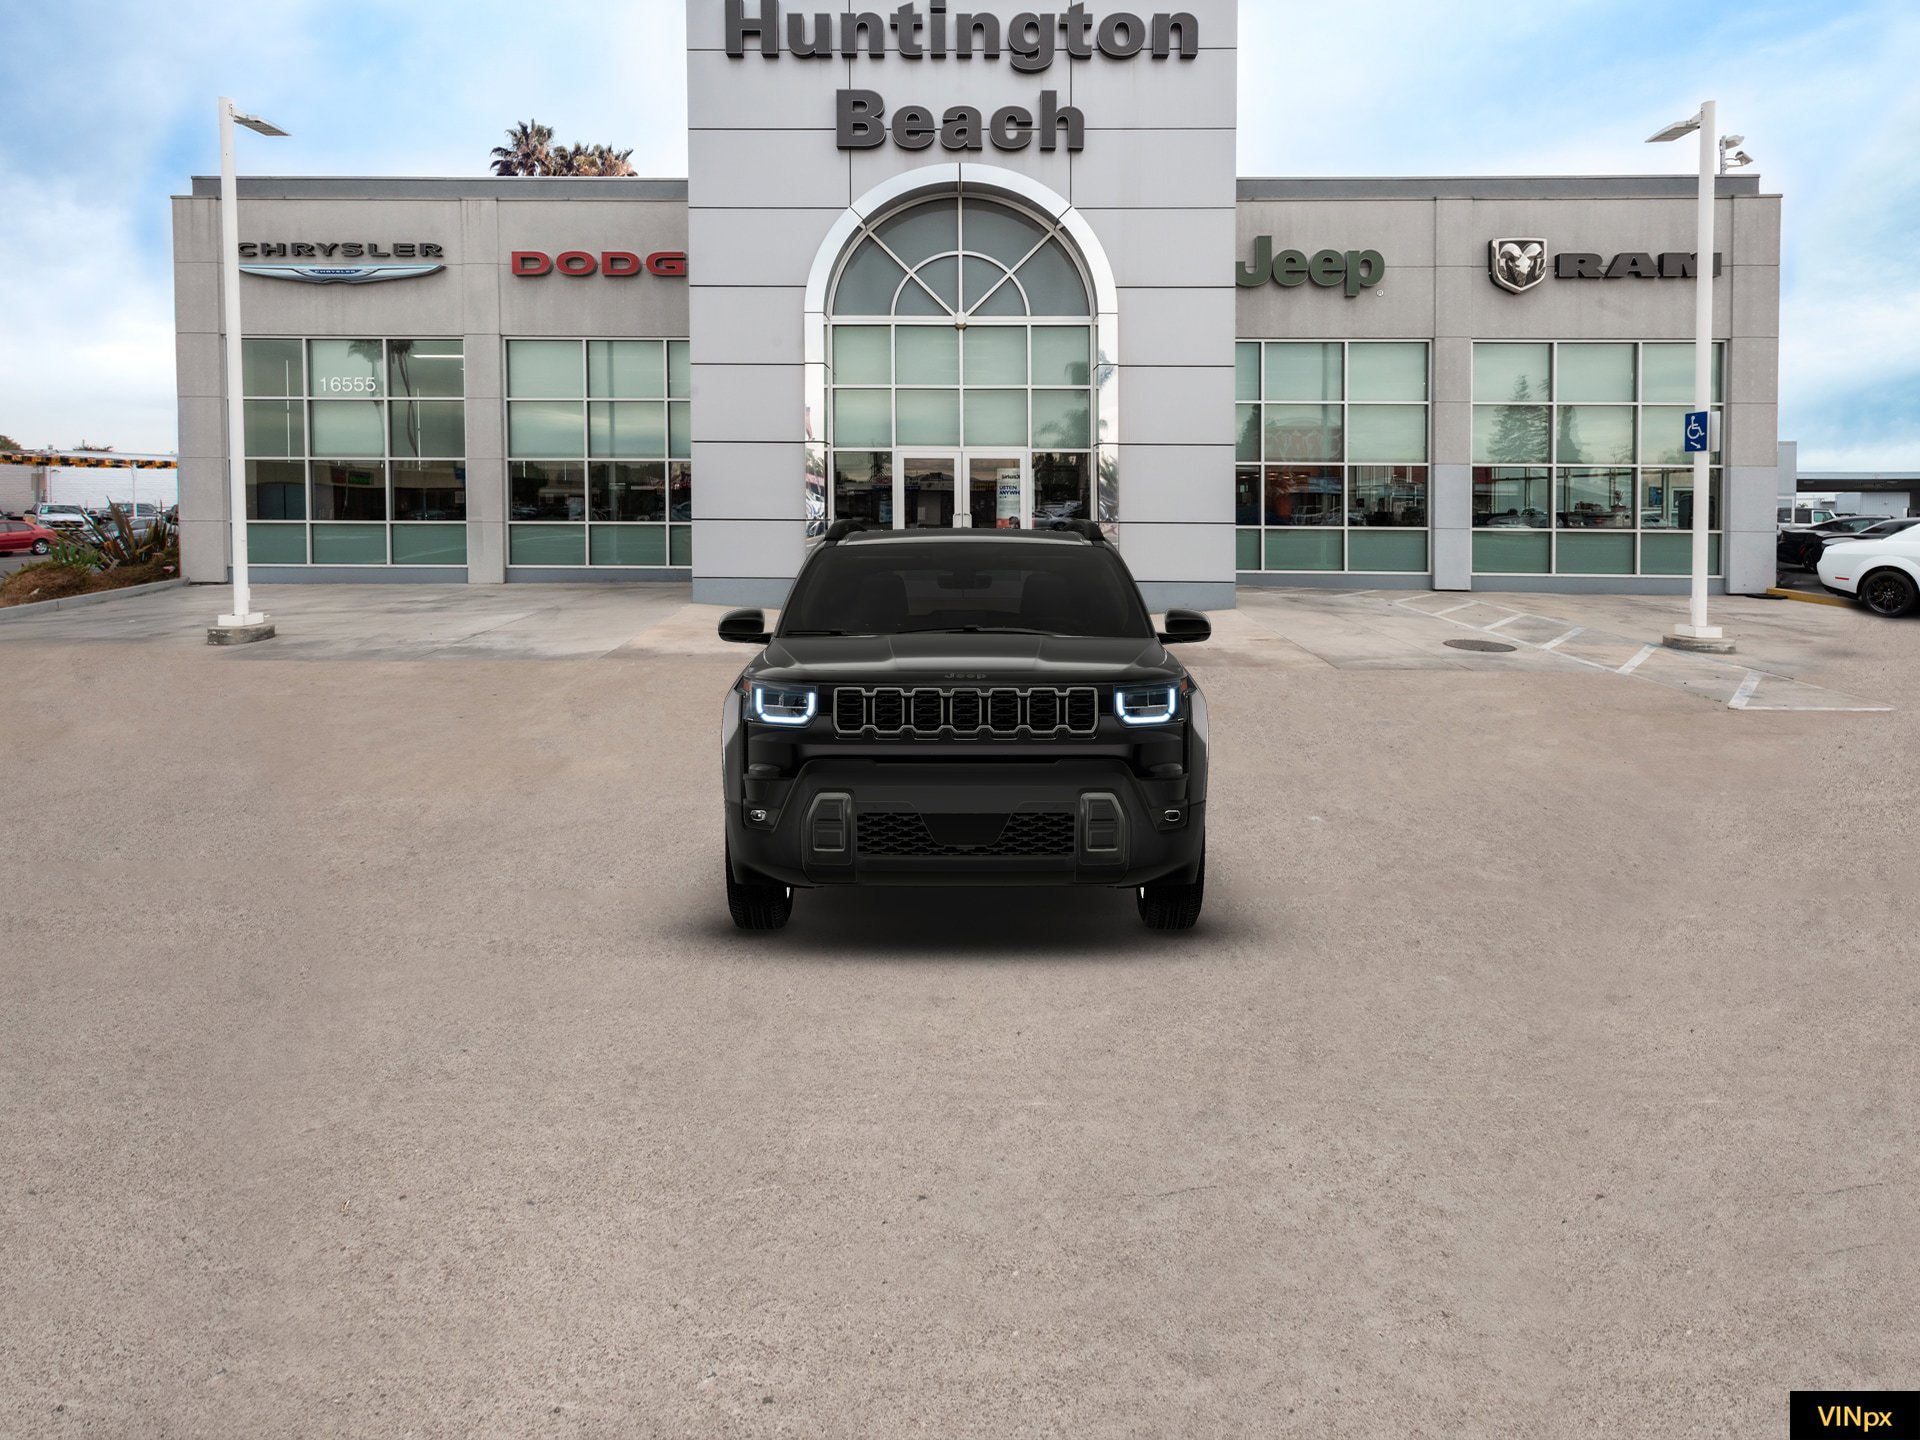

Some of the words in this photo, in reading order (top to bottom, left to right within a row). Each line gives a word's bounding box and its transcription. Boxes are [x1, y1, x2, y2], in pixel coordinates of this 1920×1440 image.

[725, 0, 1198, 73] Huntington
[836, 89, 1084, 151] Beach
[239, 242, 444, 258] CHRYSLER
[512, 251, 687, 277] DODG
[1236, 235, 1385, 298] Jeep
[1554, 252, 1722, 279] RAM
[320, 376, 377, 392] 16555
